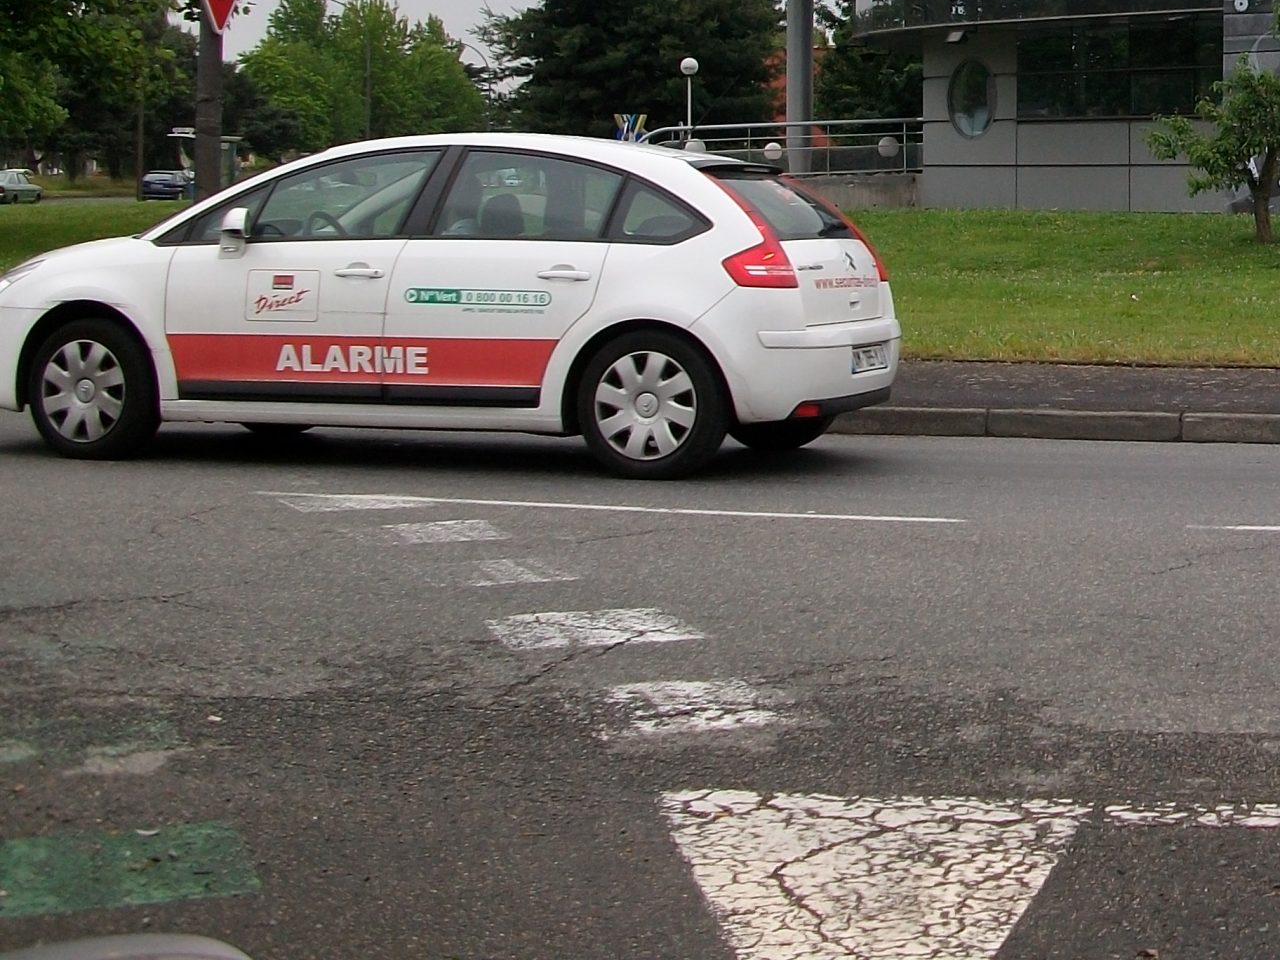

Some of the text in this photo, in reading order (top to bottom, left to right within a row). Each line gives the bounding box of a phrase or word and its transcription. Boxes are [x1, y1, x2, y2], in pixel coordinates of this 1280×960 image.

[254, 289, 311, 315] Direct
[466, 292, 473, 302] 0
[476, 292, 496, 303] 800
[499, 292, 513, 303] 00
[517, 293, 529, 303] 16
[533, 293, 546, 304] 16
[275, 344, 430, 374] ALARME
